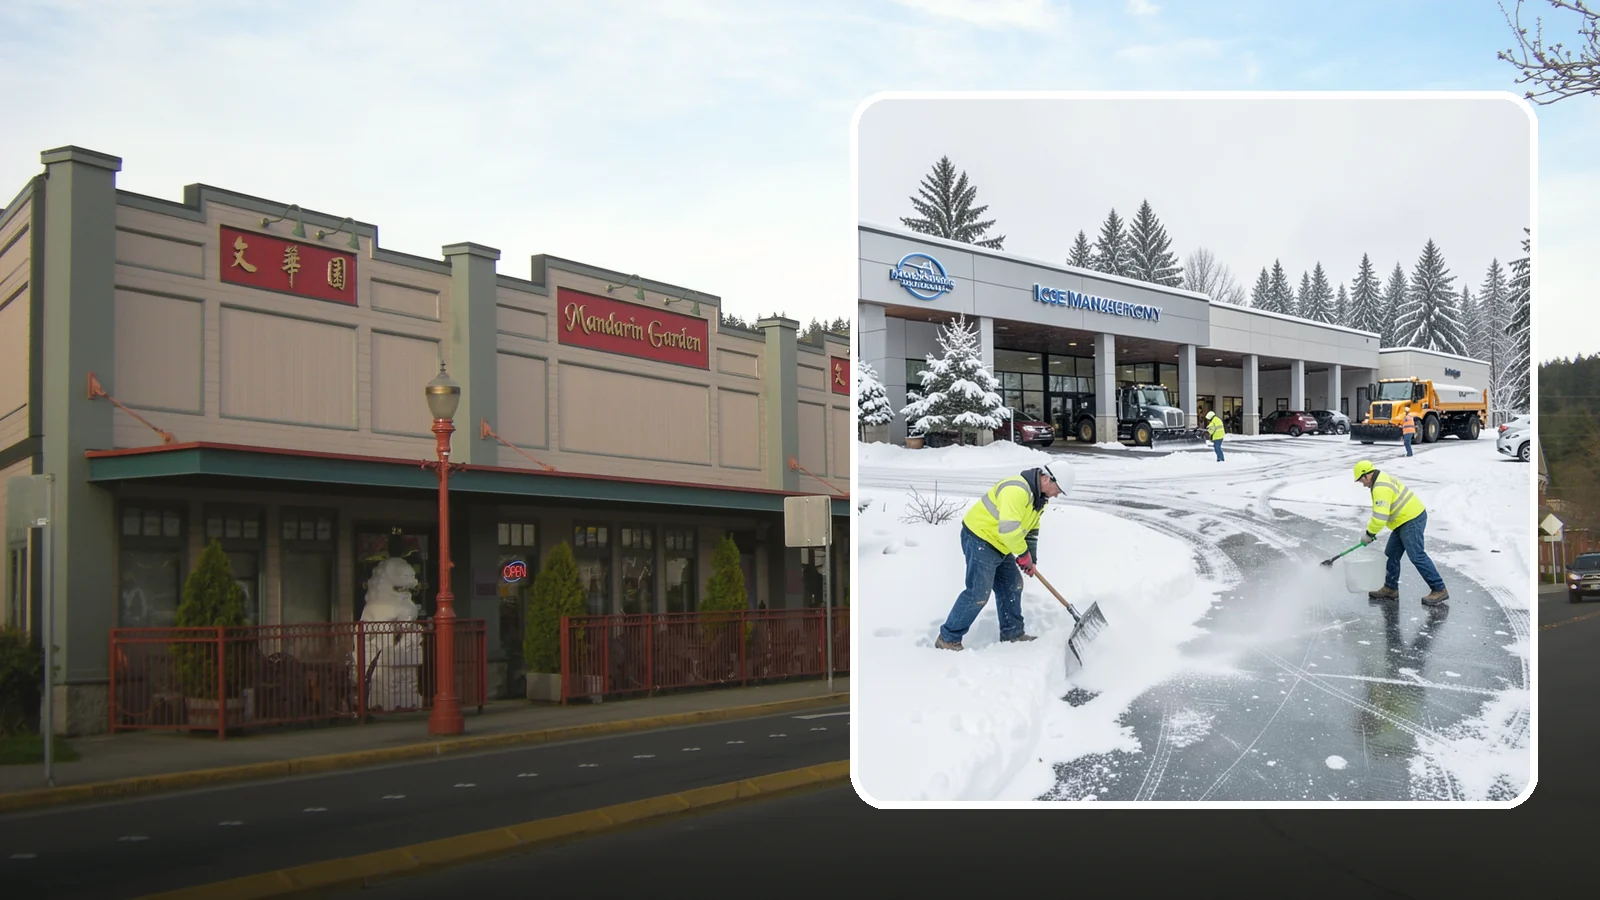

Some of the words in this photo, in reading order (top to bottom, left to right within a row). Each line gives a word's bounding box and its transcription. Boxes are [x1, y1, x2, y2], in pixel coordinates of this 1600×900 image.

[564, 302, 644, 341] Mandarin
[648, 320, 701, 352] Garden
[503, 565, 527, 578] OPEN
